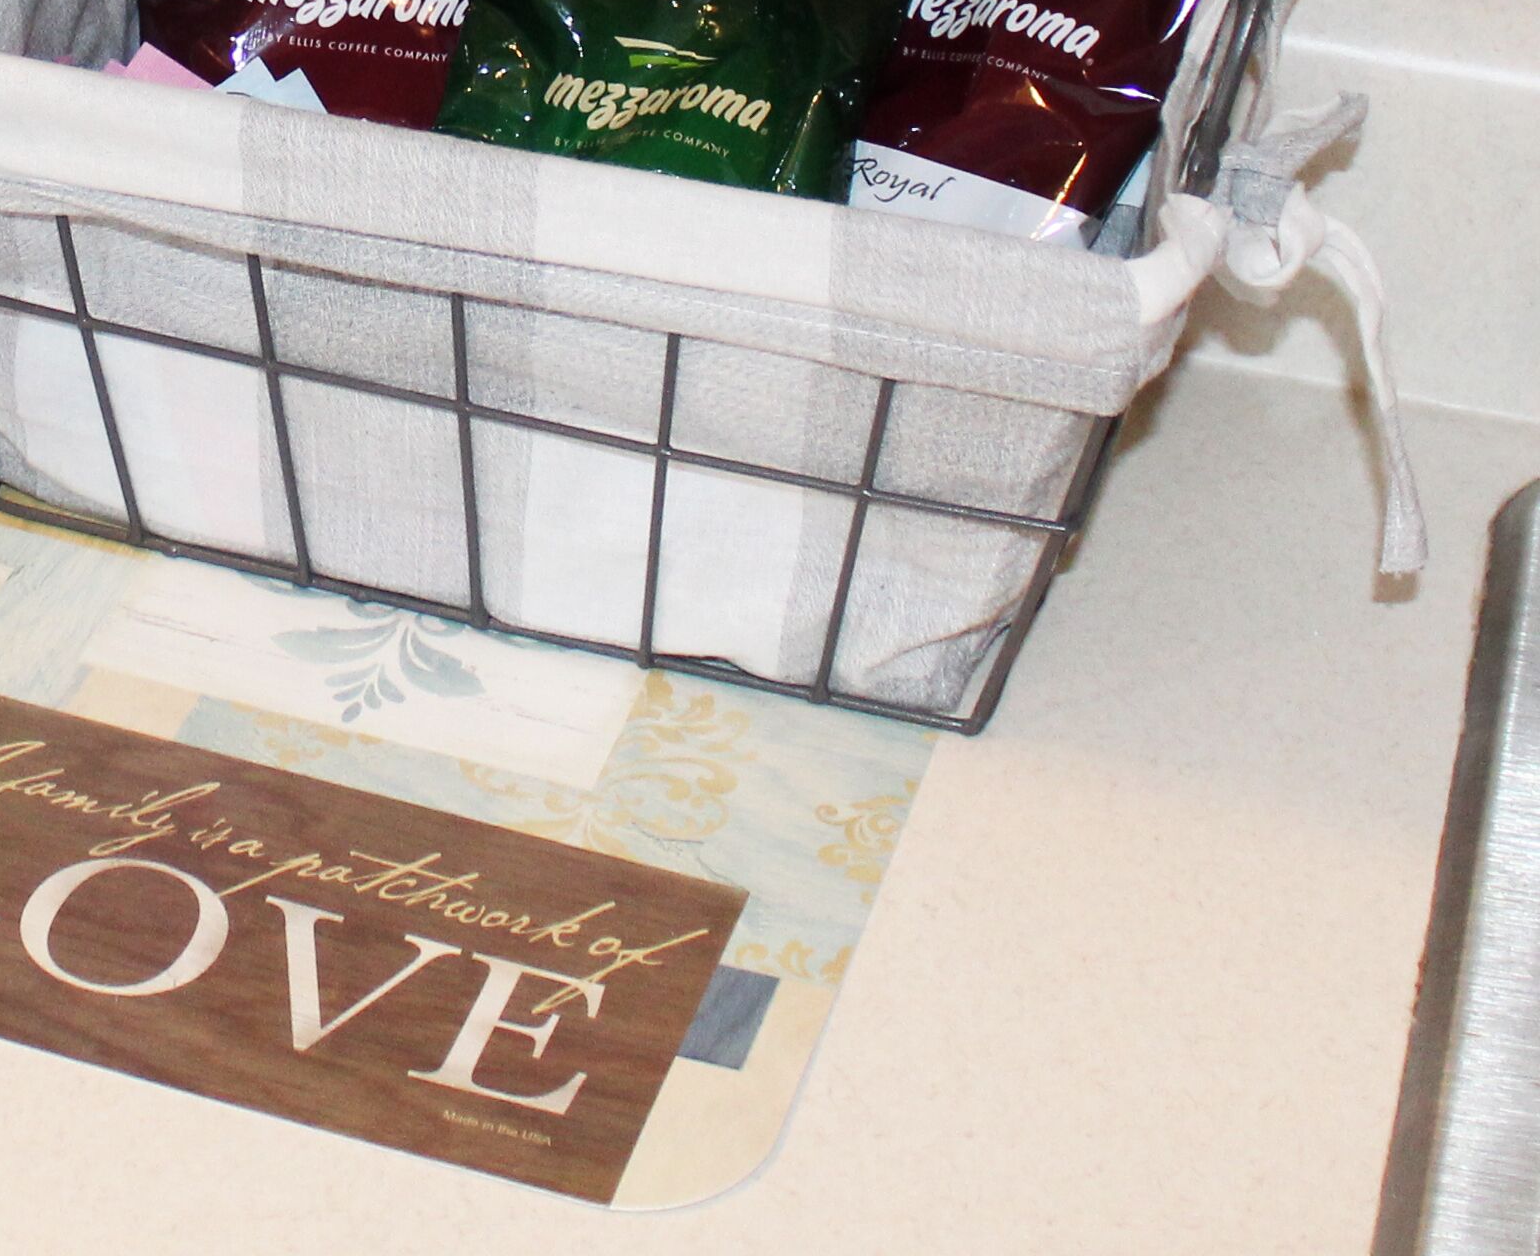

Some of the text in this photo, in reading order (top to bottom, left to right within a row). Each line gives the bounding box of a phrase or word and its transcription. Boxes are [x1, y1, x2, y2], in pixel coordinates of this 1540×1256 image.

[288, 34, 323, 49] ELLIS
[327, 40, 378, 55] COFFEE
[383, 46, 450, 63] COMPANY
[986, 55, 1050, 82] COMPANY
[543, 71, 773, 132] mezzaroma
[662, 128, 731, 159] COMPANY
[851, 156, 957, 203] Royal
[189, 817, 233, 851] is
[228, 837, 266, 859] a
[218, 849, 617, 947] patchwork
[530, 928, 710, 1015] of
